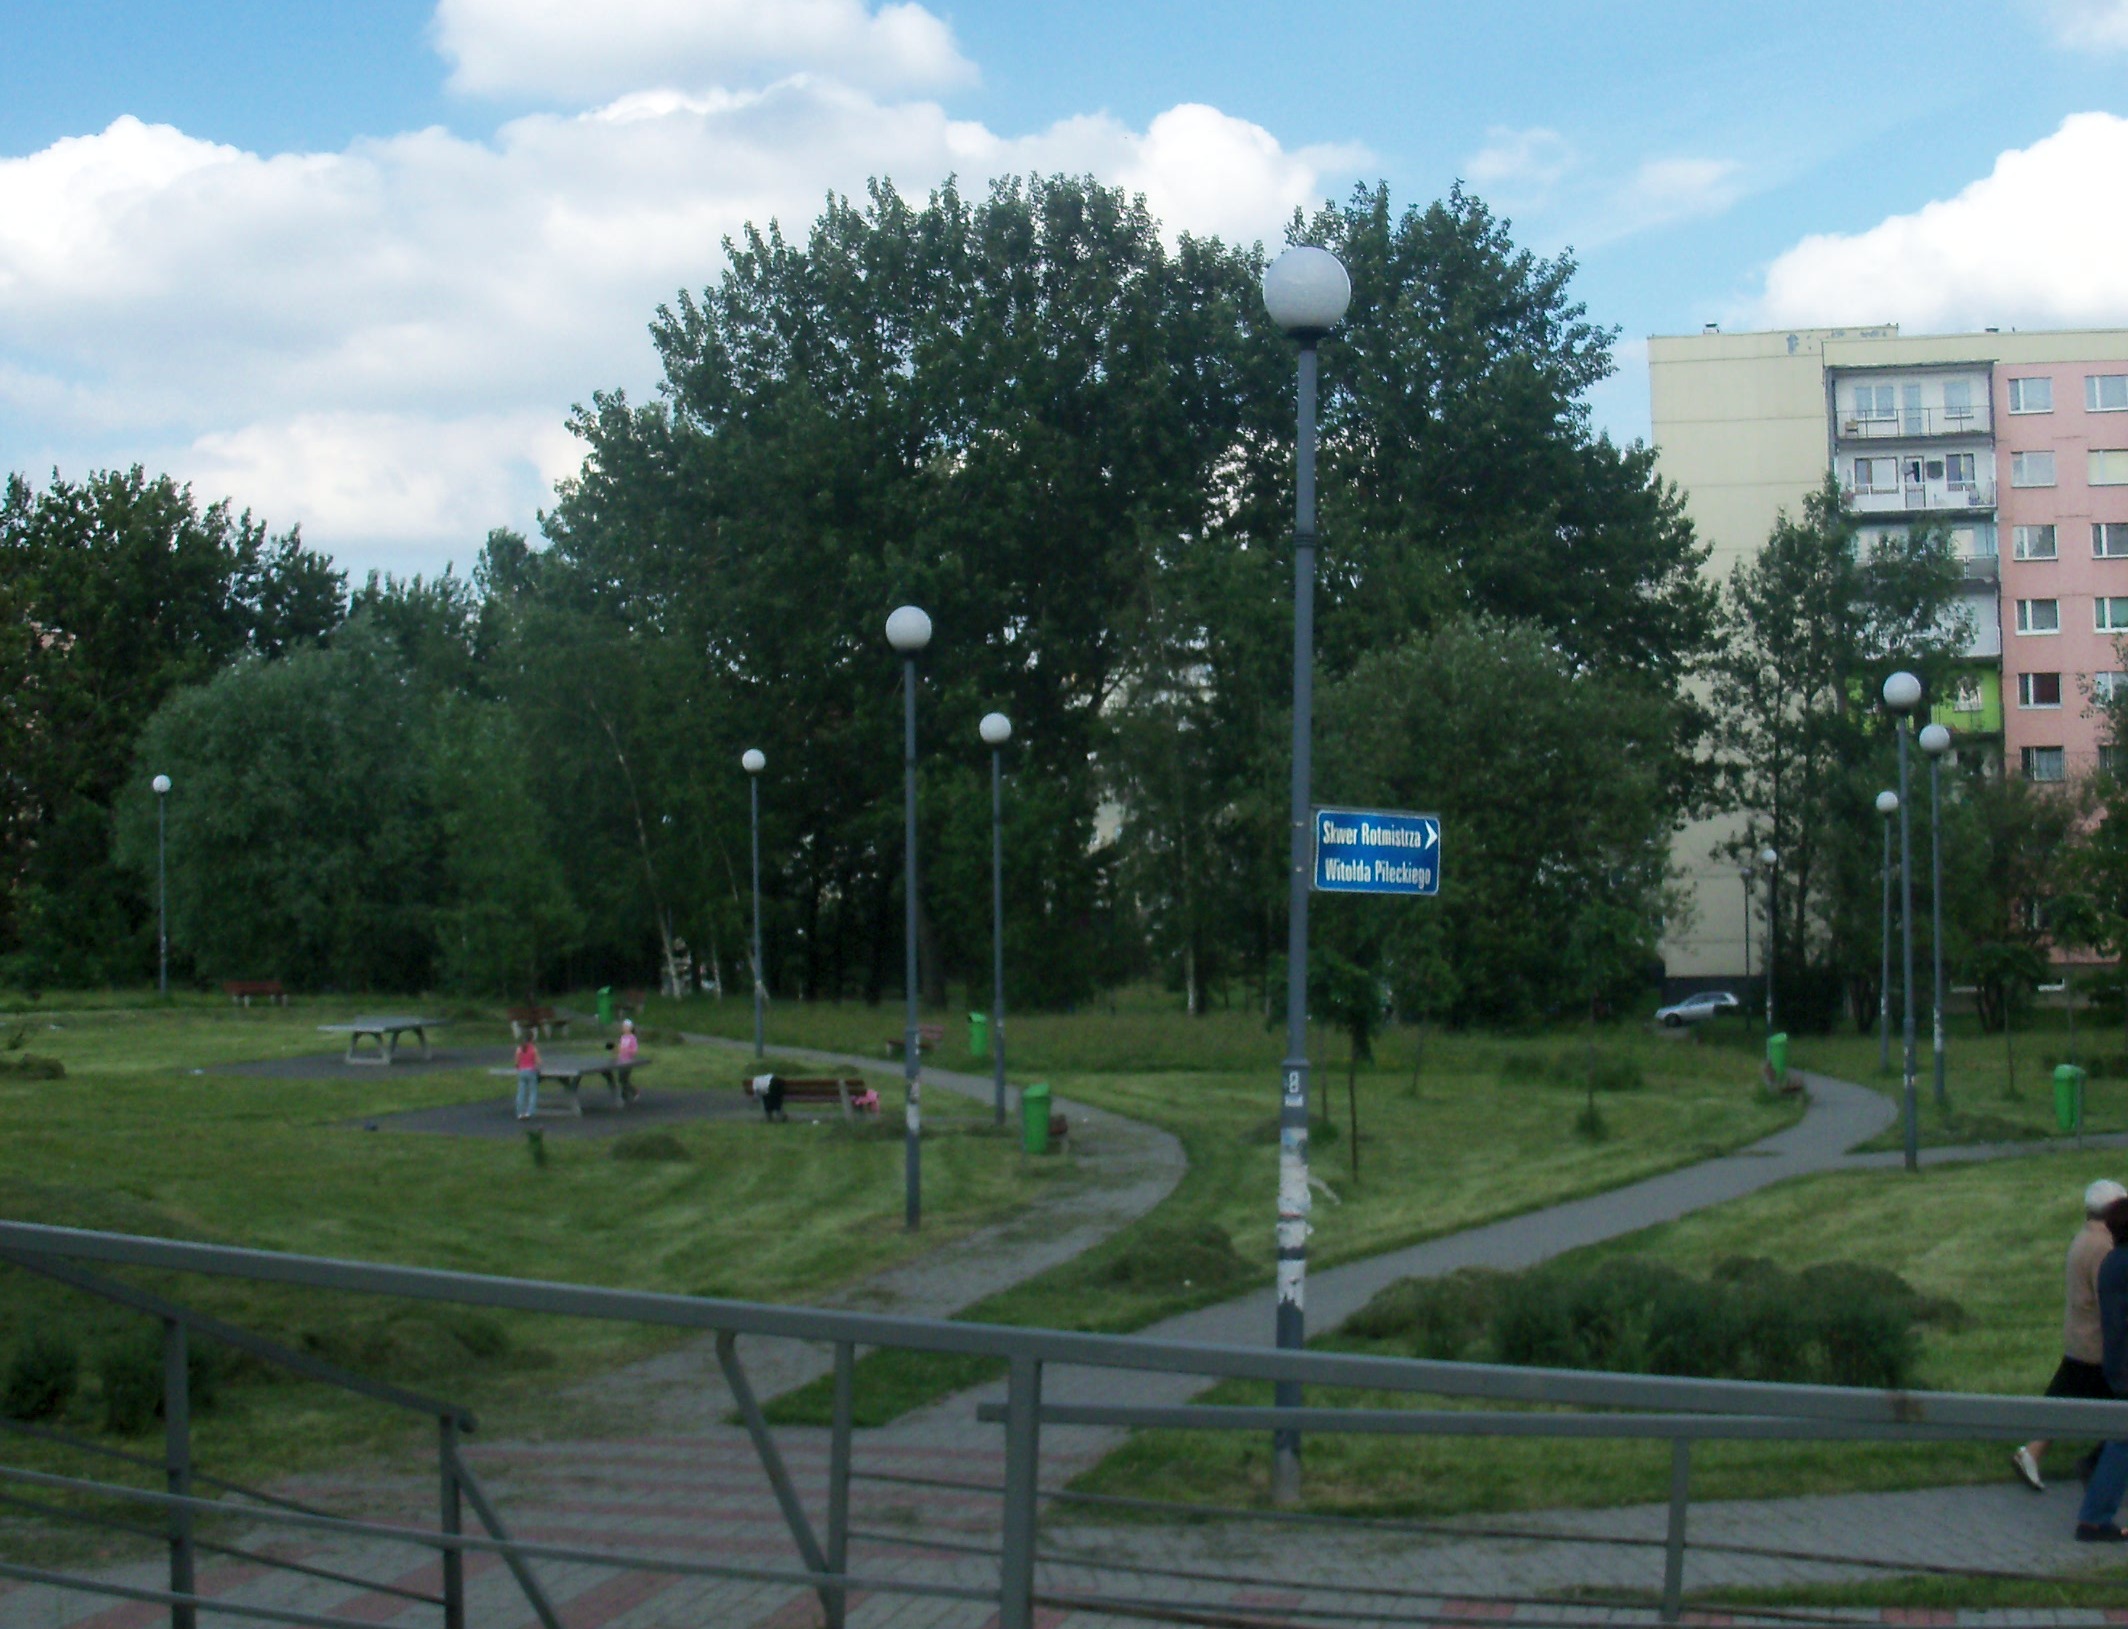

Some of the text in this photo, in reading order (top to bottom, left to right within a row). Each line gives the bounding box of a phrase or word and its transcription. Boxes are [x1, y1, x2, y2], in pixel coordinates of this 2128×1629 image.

[1323, 820, 1421, 848] Skwer Rotmistrza
[1325, 858, 1431, 890] Witolda Pileckiego
